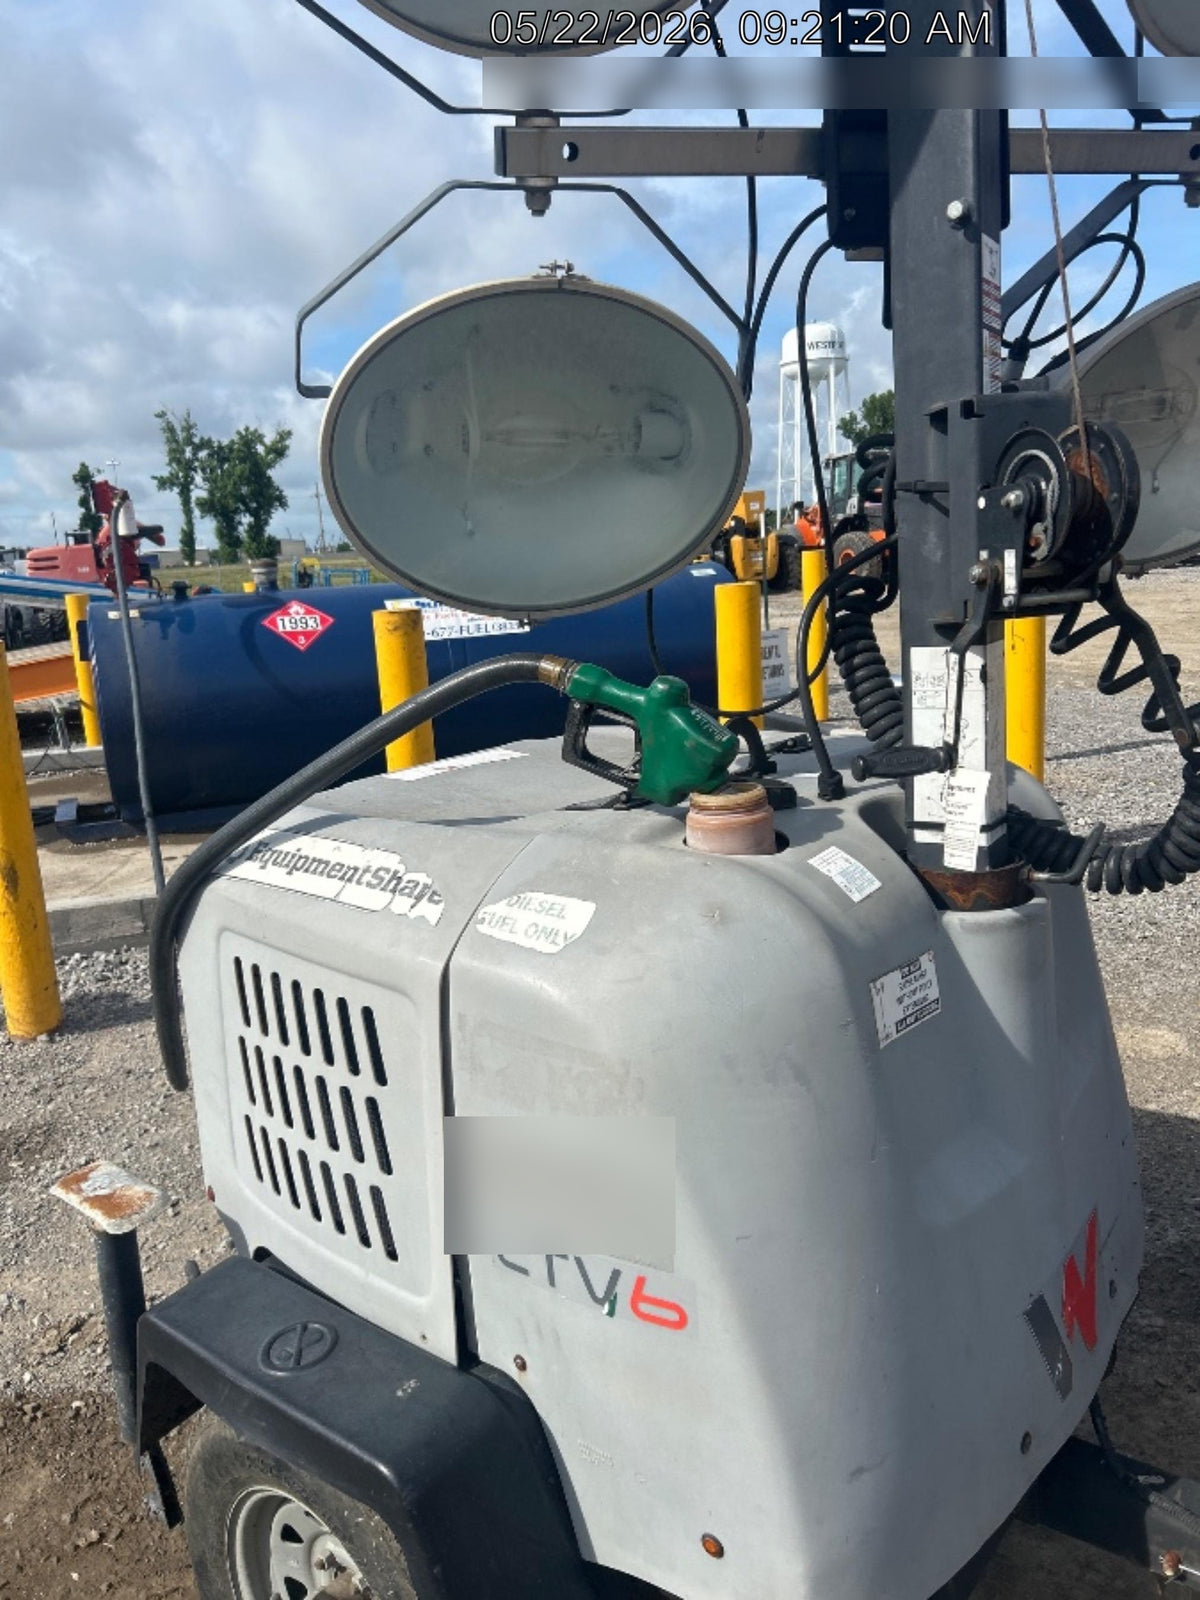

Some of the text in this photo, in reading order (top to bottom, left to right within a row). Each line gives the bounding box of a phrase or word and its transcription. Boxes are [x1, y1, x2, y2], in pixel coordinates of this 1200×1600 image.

[279, 616, 319, 630] 1993
[298, 635, 306, 645] 3
[506, 895, 566, 920] DIESEL
[524, 921, 578, 947] ONLY
